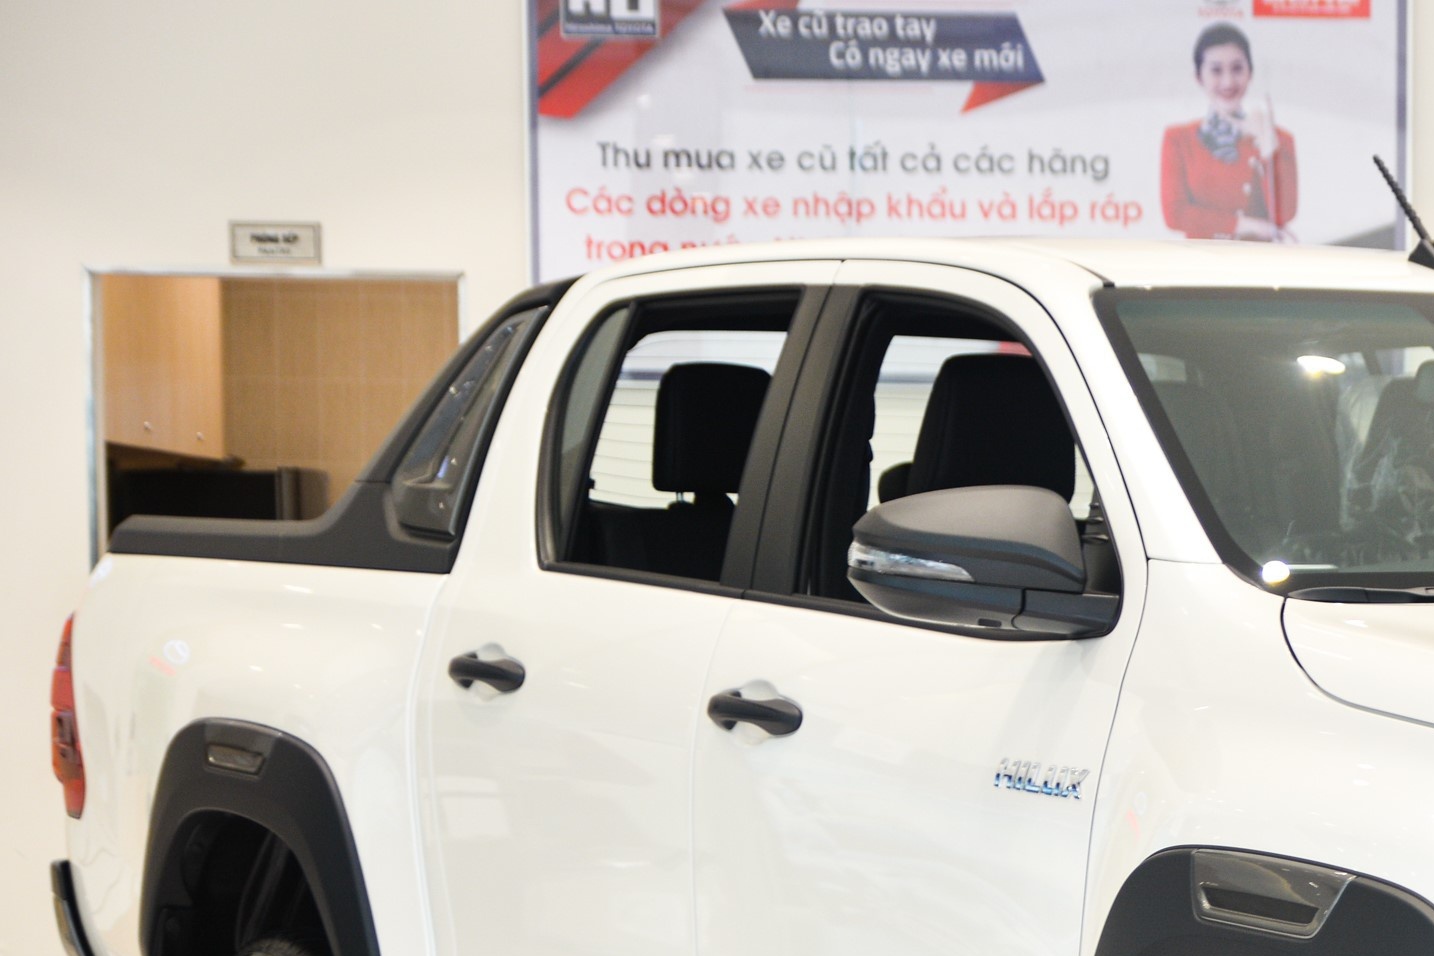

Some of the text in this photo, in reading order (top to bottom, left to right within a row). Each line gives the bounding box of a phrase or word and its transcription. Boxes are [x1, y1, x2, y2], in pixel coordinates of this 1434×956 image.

[758, 9, 936, 44] Xe cũ trao tay
[868, 46, 932, 76] ngay
[938, 49, 967, 69] xe
[597, 141, 652, 169] Thu
[662, 148, 735, 170] mua
[749, 150, 785, 170] xe
[797, 144, 837, 170] cũ
[848, 140, 889, 172] tất
[900, 142, 942, 173] cả
[953, 146, 1015, 173] các
[565, 186, 634, 215] Các
[646, 187, 731, 223] dòng
[743, 197, 781, 216] xe
[792, 191, 876, 226] nhập
[887, 186, 967, 221] khẩu
[978, 191, 1018, 221] và
[1090, 192, 1143, 228] ráp
[994, 757, 1090, 799] HILUX
